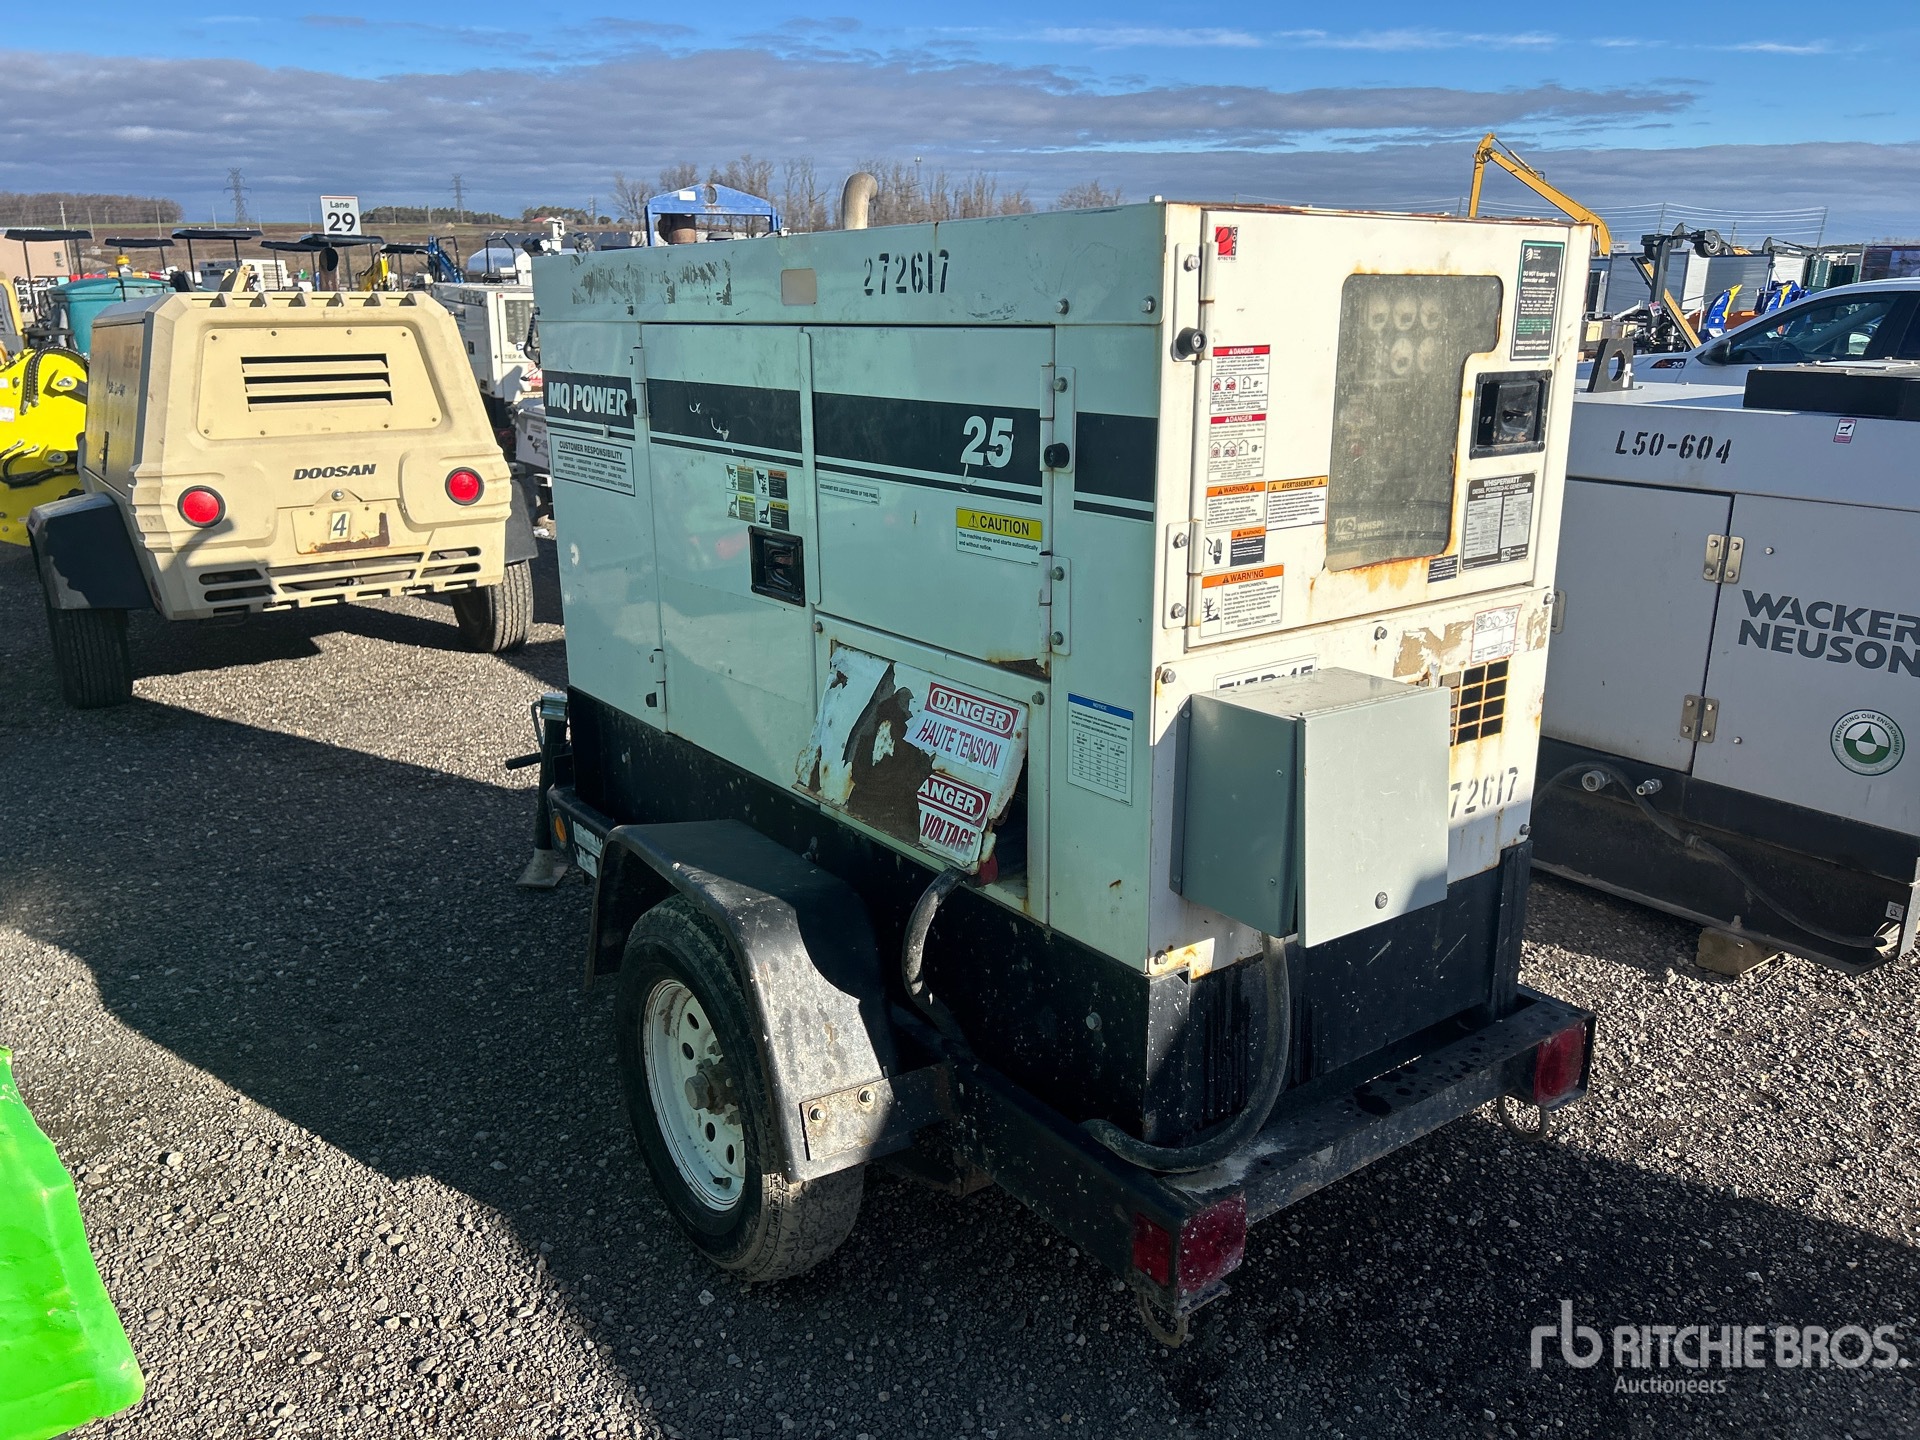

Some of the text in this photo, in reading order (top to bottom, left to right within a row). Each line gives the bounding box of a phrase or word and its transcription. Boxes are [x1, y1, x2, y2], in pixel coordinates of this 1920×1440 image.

[327, 212, 356, 232] 29
[864, 249, 949, 296] 272617
[1233, 347, 1254, 355] DANGER
[548, 381, 628, 417] MQ POWER
[559, 440, 623, 460] CUSTOMER RESPONSIBILITY
[960, 415, 1013, 468] 25
[1615, 430, 1732, 464] L50-604
[293, 463, 377, 481] DOOSAN
[1223, 485, 1249, 493] WARNING
[1282, 479, 1315, 489] AVERTISSEMENT
[332, 513, 347, 537] 4
[980, 515, 1029, 536] CAUTION
[1230, 569, 1264, 582] WARNING
[1742, 589, 1920, 646] WACKER
[1737, 619, 1920, 678] NEUSON
[935, 692, 1007, 730] DANGER
[915, 718, 1001, 770] HAUTE TENSION
[1876, 716, 1900, 756] ENVIRONMENT
[917, 779, 977, 815] ANGER
[1450, 767, 1519, 819] 72617
[921, 813, 977, 856] VOLTAGE
